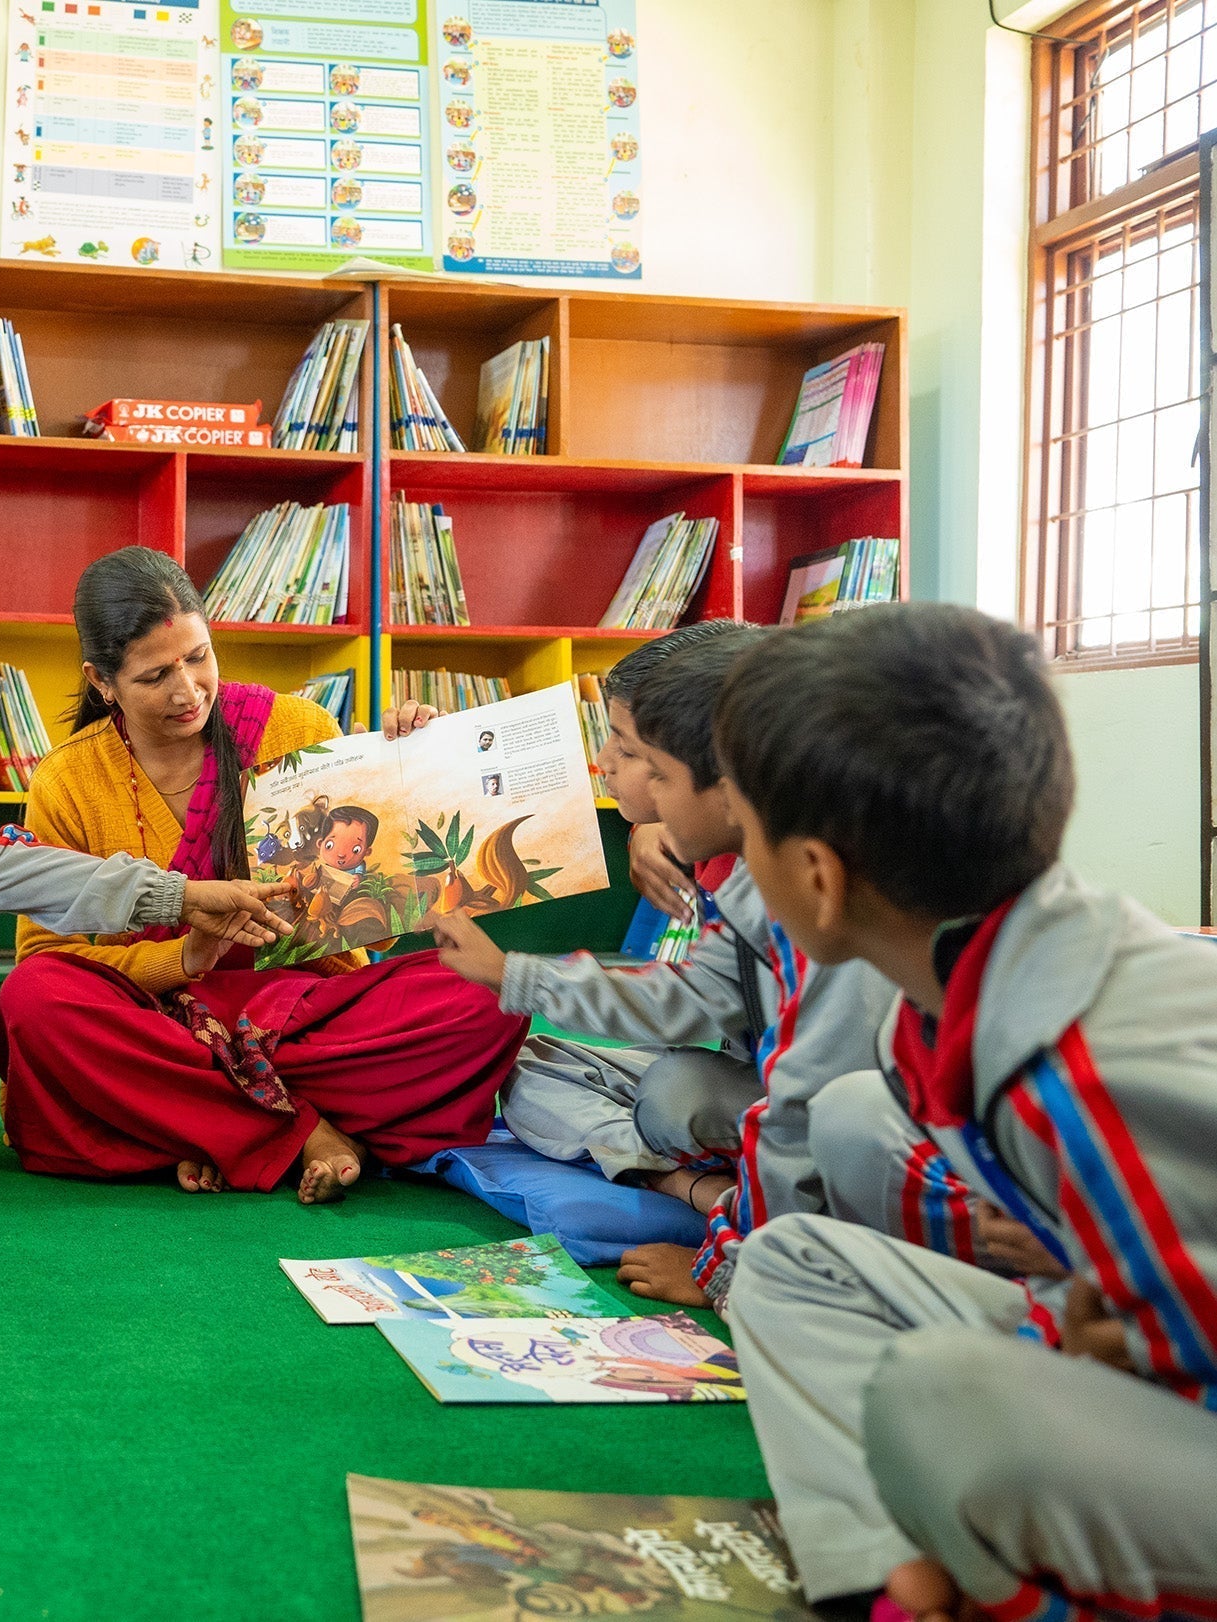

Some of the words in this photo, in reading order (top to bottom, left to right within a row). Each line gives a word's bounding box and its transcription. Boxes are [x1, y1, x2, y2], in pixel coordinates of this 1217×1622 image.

[133, 404, 163, 419] JK
[166, 405, 226, 422] COPIER
[151, 427, 183, 443] JK
[184, 429, 244, 446] COPIER
